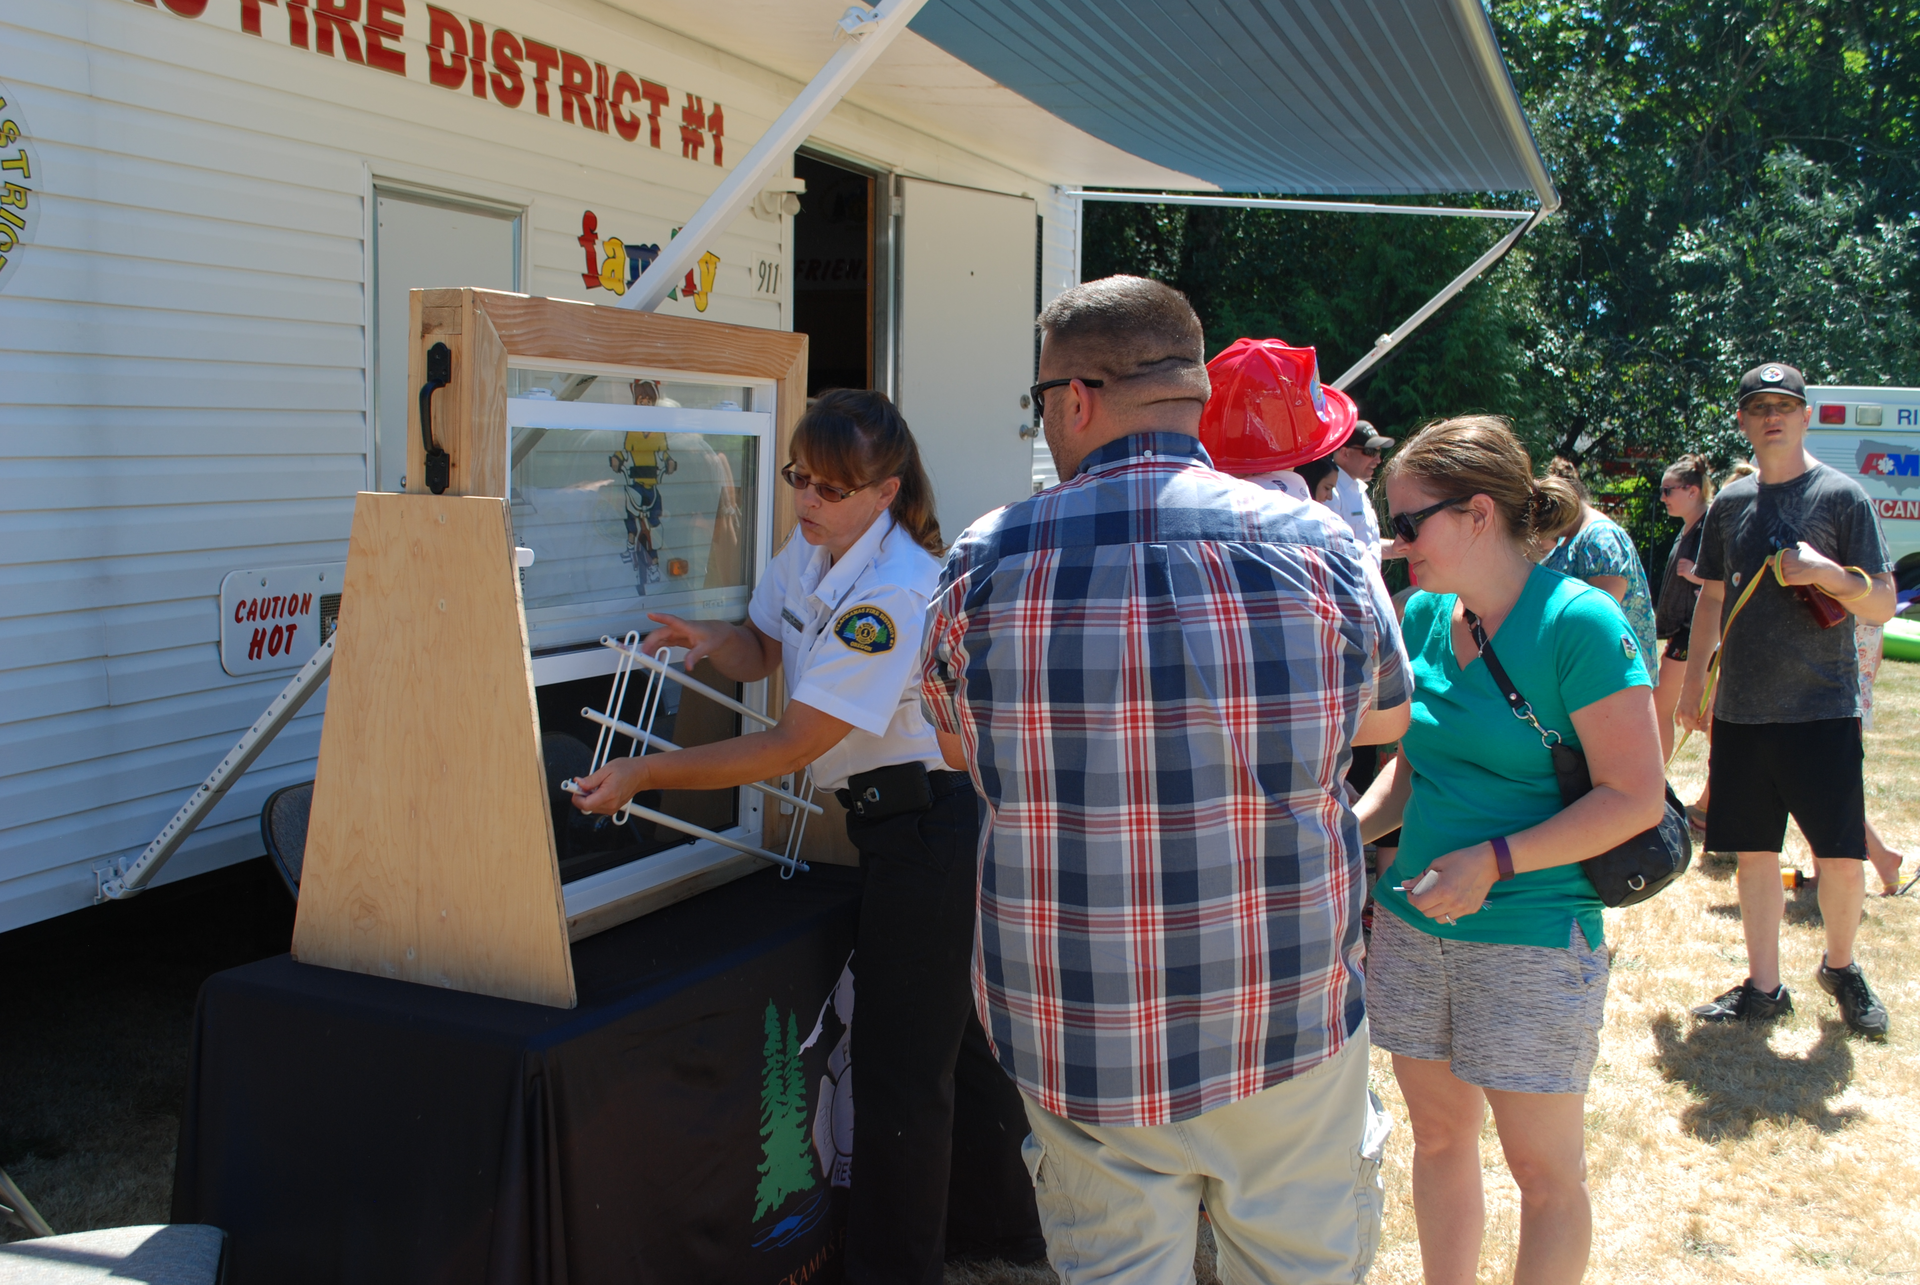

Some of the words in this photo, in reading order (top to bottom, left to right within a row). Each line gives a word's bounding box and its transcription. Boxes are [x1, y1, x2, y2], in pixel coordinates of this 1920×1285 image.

[427, 3, 670, 149] DISTRICT
[680, 92, 725, 167] #1
[577, 210, 721, 313] famy
[757, 260, 780, 295] 911
[795, 258, 867, 282] FRIEN
[234, 592, 313, 624] CAUTION
[248, 623, 298, 661] HOT
